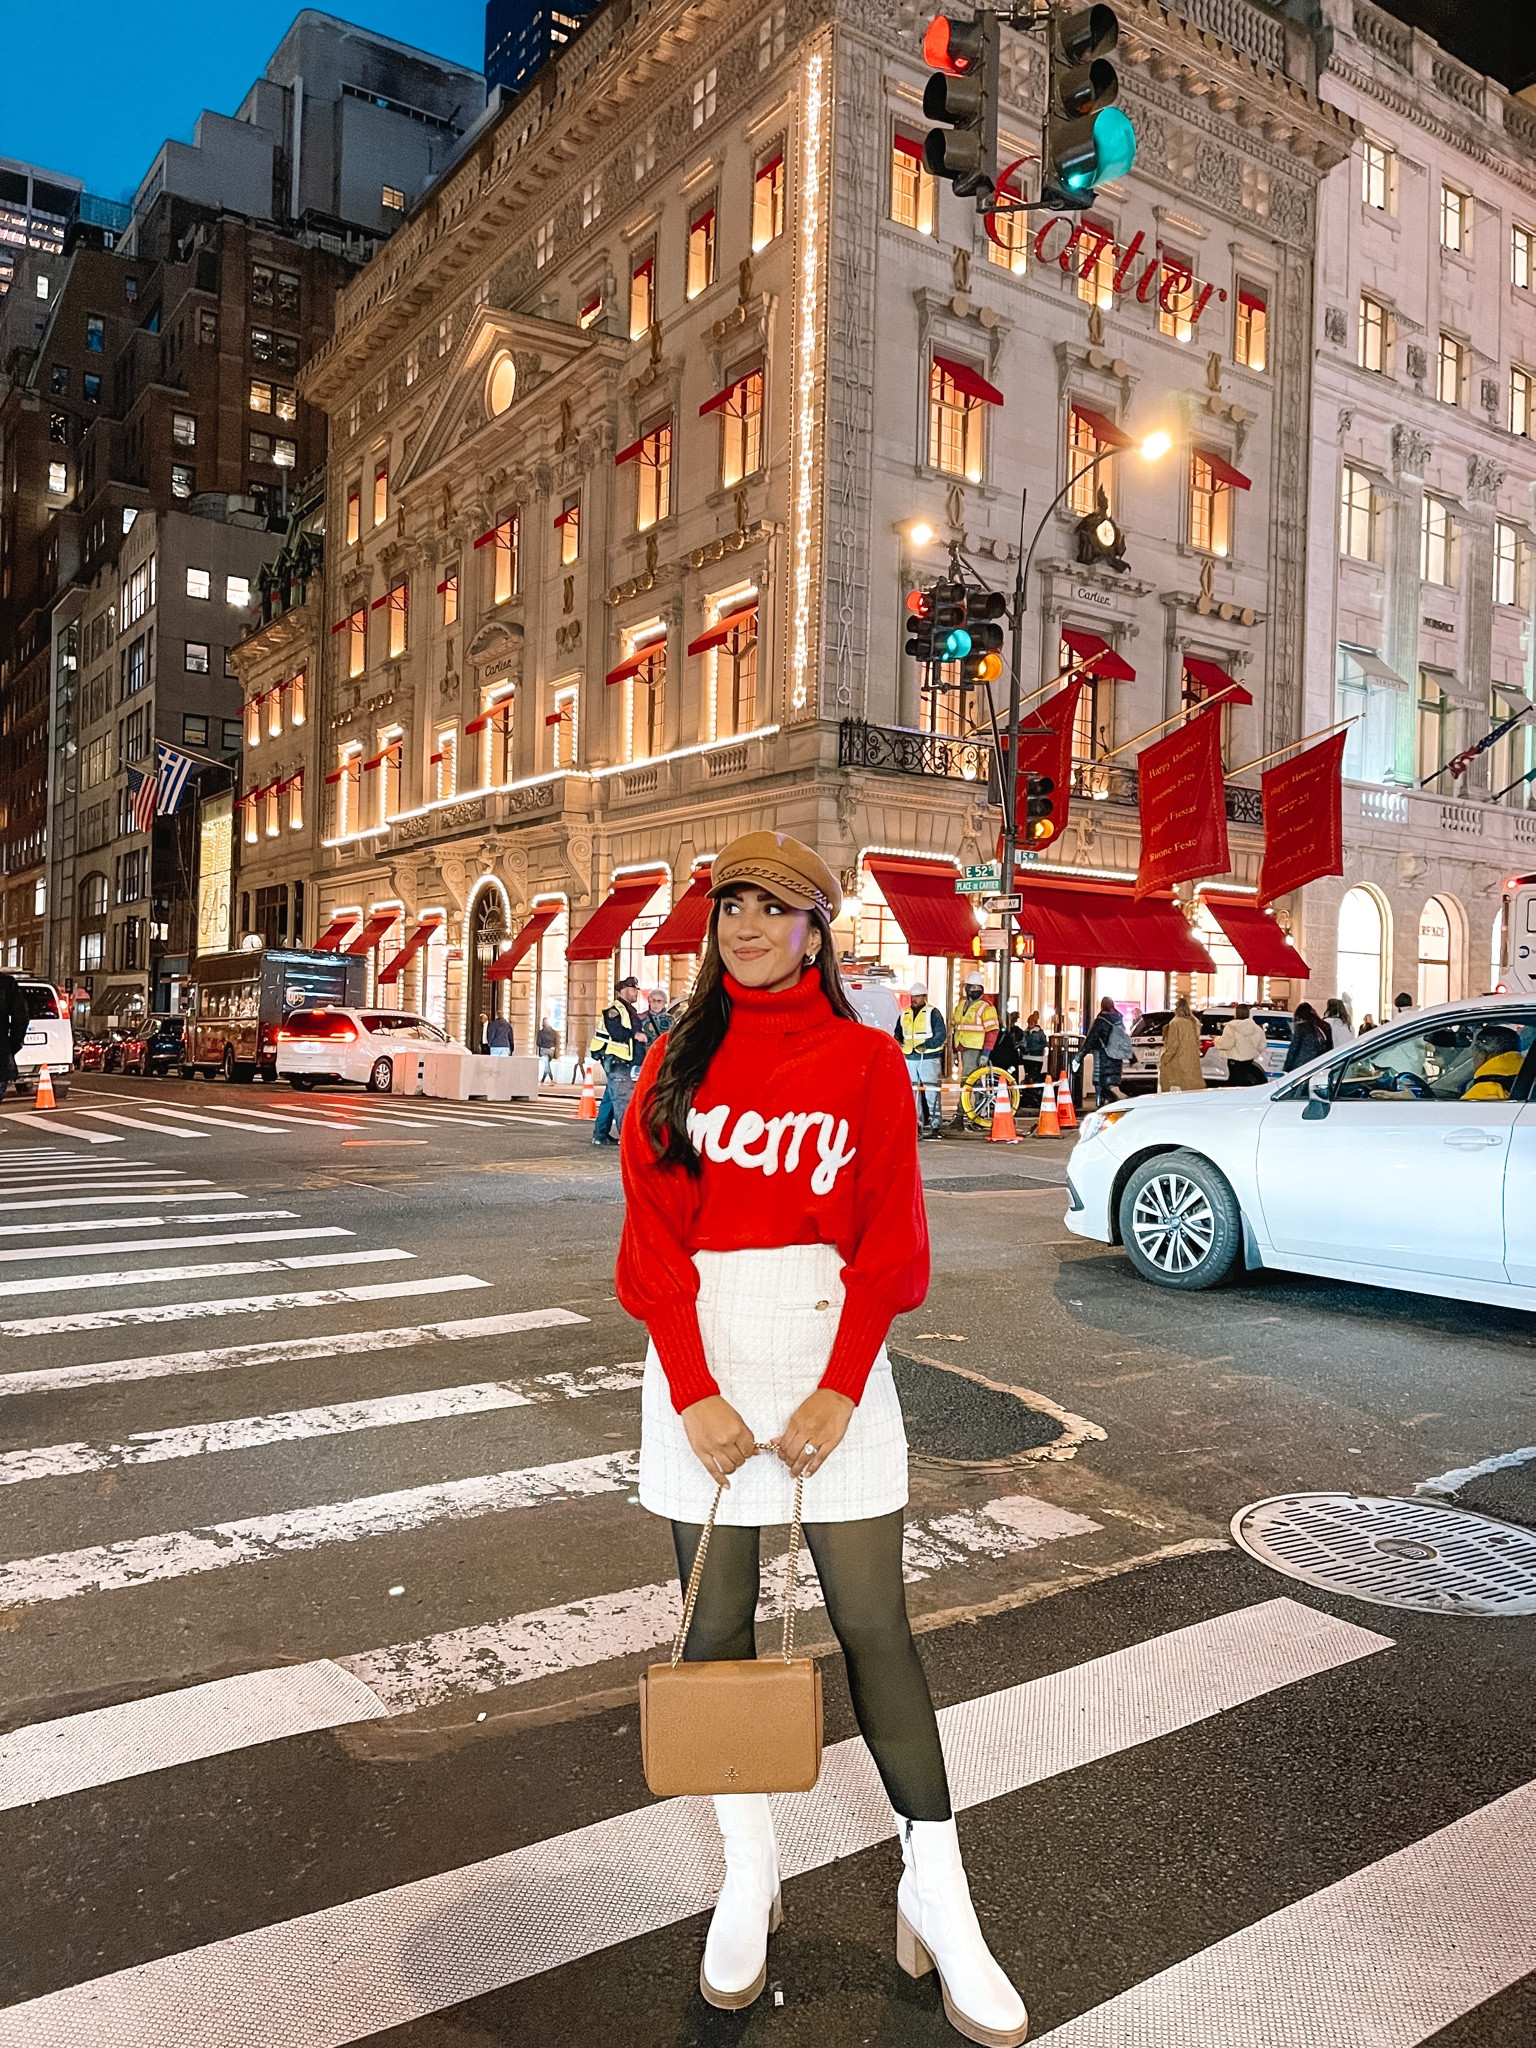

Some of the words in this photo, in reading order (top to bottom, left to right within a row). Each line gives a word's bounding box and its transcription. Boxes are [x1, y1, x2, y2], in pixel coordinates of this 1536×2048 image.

[983, 155, 1228, 324] Cartier
[1078, 588, 1111, 605] Cartier
[485, 659, 512, 676] Cartier
[1022, 852, 1028, 862] 5
[966, 867, 972, 878] E
[975, 866, 988, 877] 52
[956, 882, 972, 891] PLACE
[979, 881, 999, 890] CARTIER
[200, 885, 228, 935] 645
[987, 901, 998, 909] ONE
[288, 992, 304, 1005] ups
[686, 1104, 857, 1196] merry
